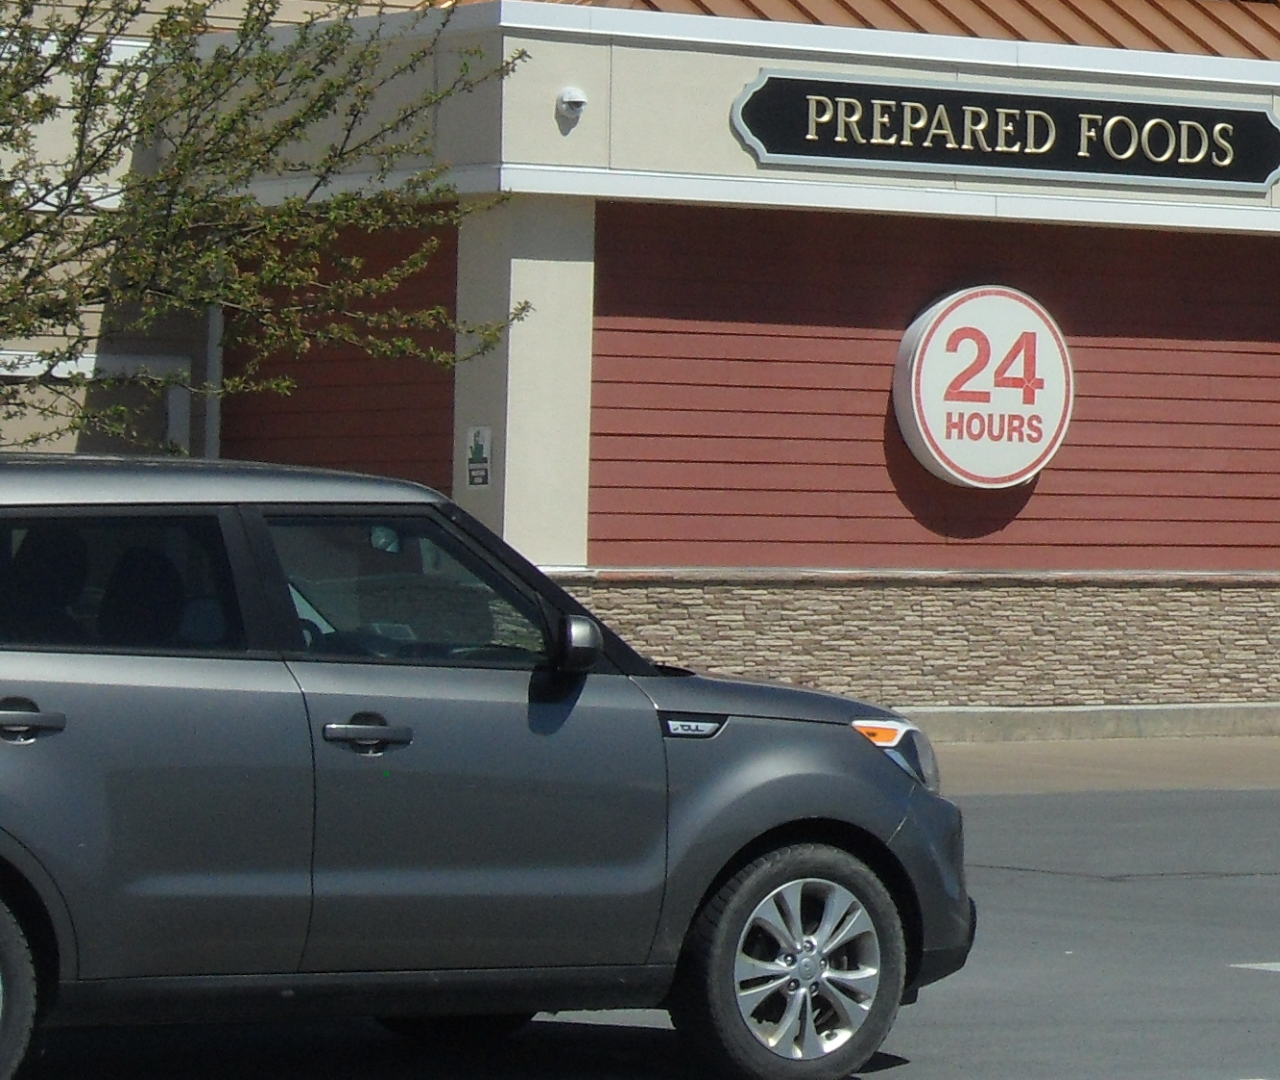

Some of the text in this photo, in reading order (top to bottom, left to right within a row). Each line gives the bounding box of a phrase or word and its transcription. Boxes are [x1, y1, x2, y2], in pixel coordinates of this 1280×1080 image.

[805, 94, 1235, 168] PREPARED FOODS
[943, 326, 1044, 405] 24
[945, 411, 1043, 443] HOURS
